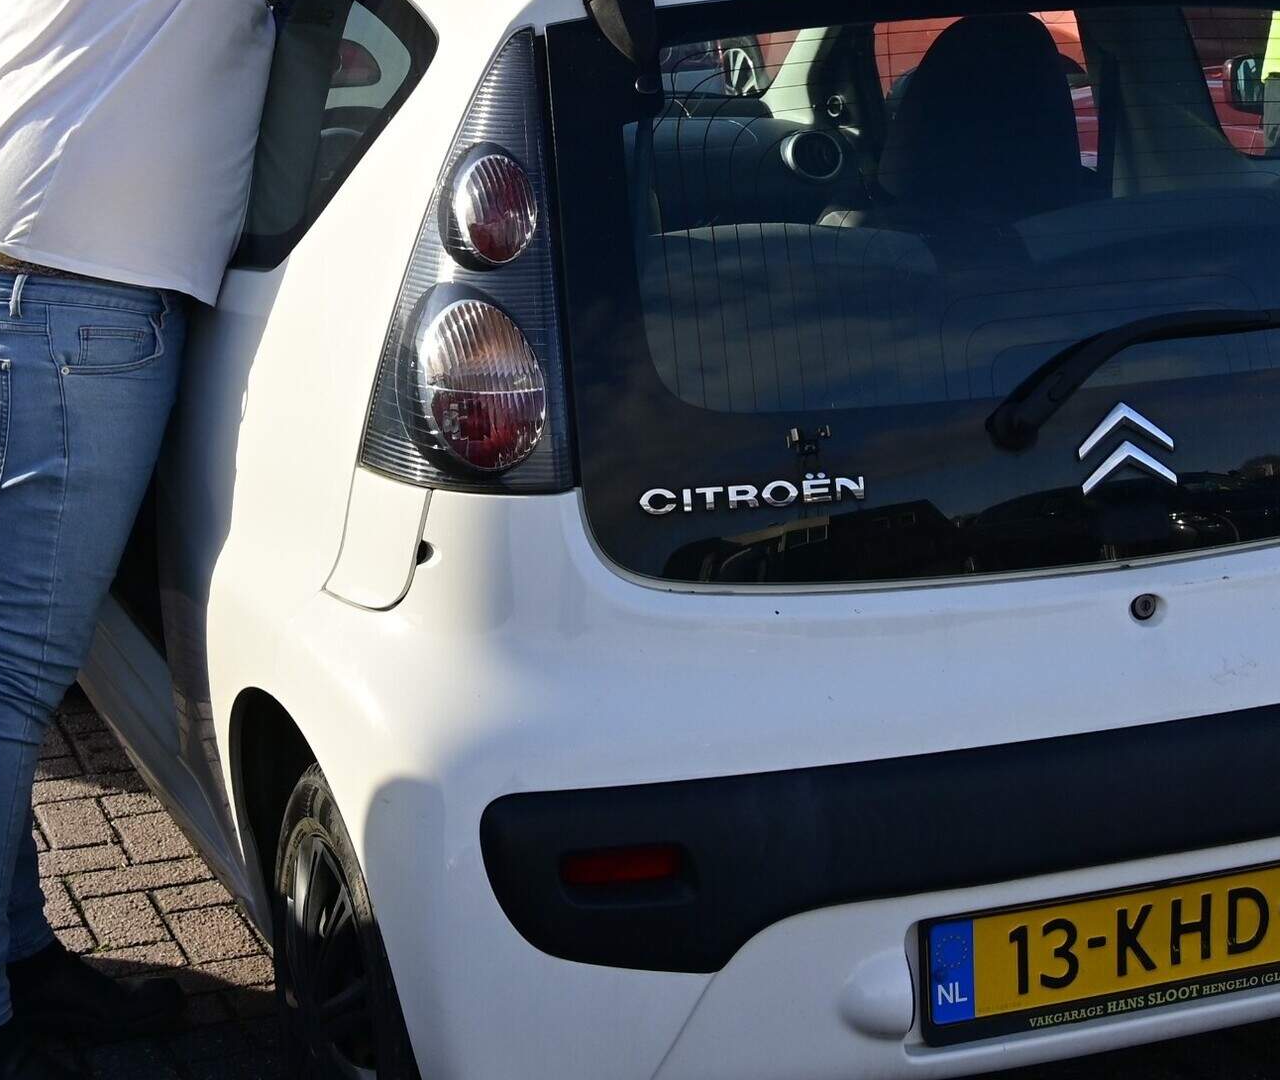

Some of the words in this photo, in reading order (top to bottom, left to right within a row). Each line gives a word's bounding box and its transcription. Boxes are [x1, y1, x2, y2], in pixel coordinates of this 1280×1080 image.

[638, 472, 866, 516] CITROËN
[936, 981, 969, 1006] NL
[1028, 1004, 1104, 1028] VAKGARAGE
[1106, 995, 1145, 1014] HANS
[1147, 984, 1200, 1006] SLOOT
[1202, 976, 1259, 995] HENGELO
